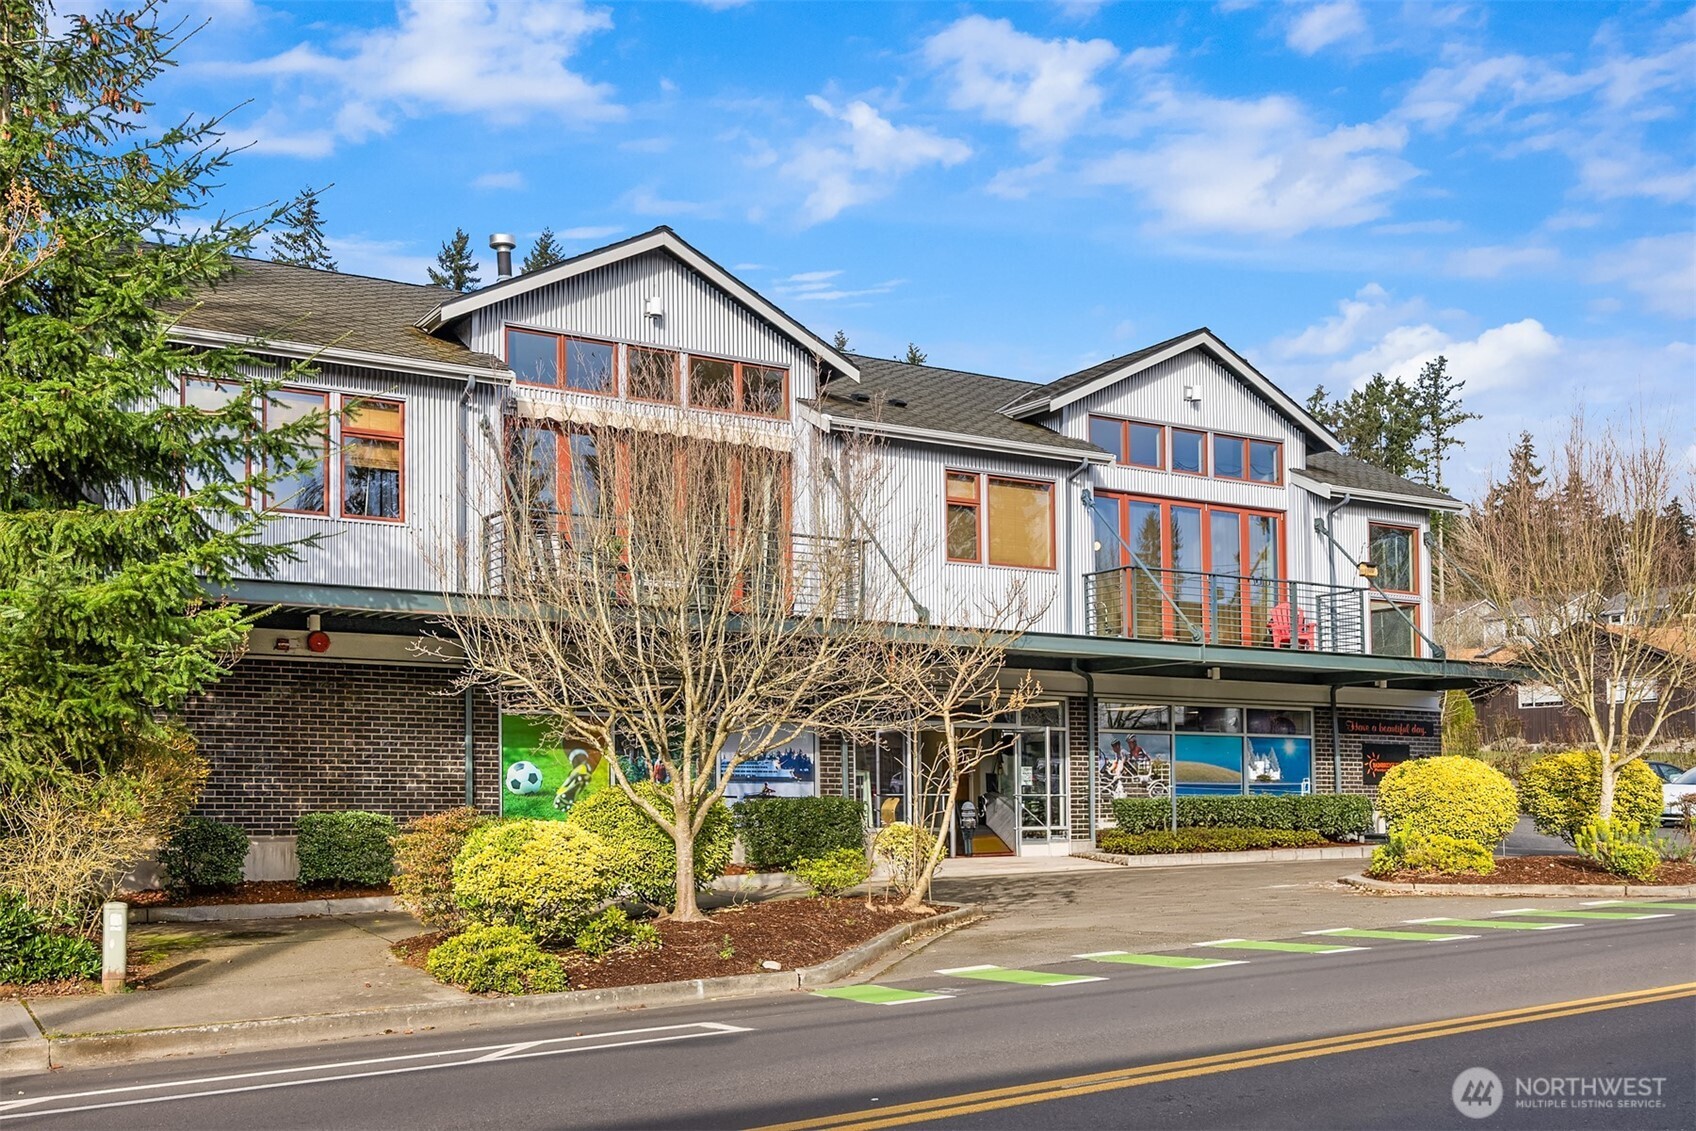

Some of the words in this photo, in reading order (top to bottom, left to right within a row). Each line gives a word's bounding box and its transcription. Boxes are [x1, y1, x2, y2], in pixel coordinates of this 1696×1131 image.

[1345, 720, 1369, 732] Have
[1371, 724, 1377, 732] a
[1378, 722, 1410, 735] beautiful
[1411, 723, 1427, 736] day.
